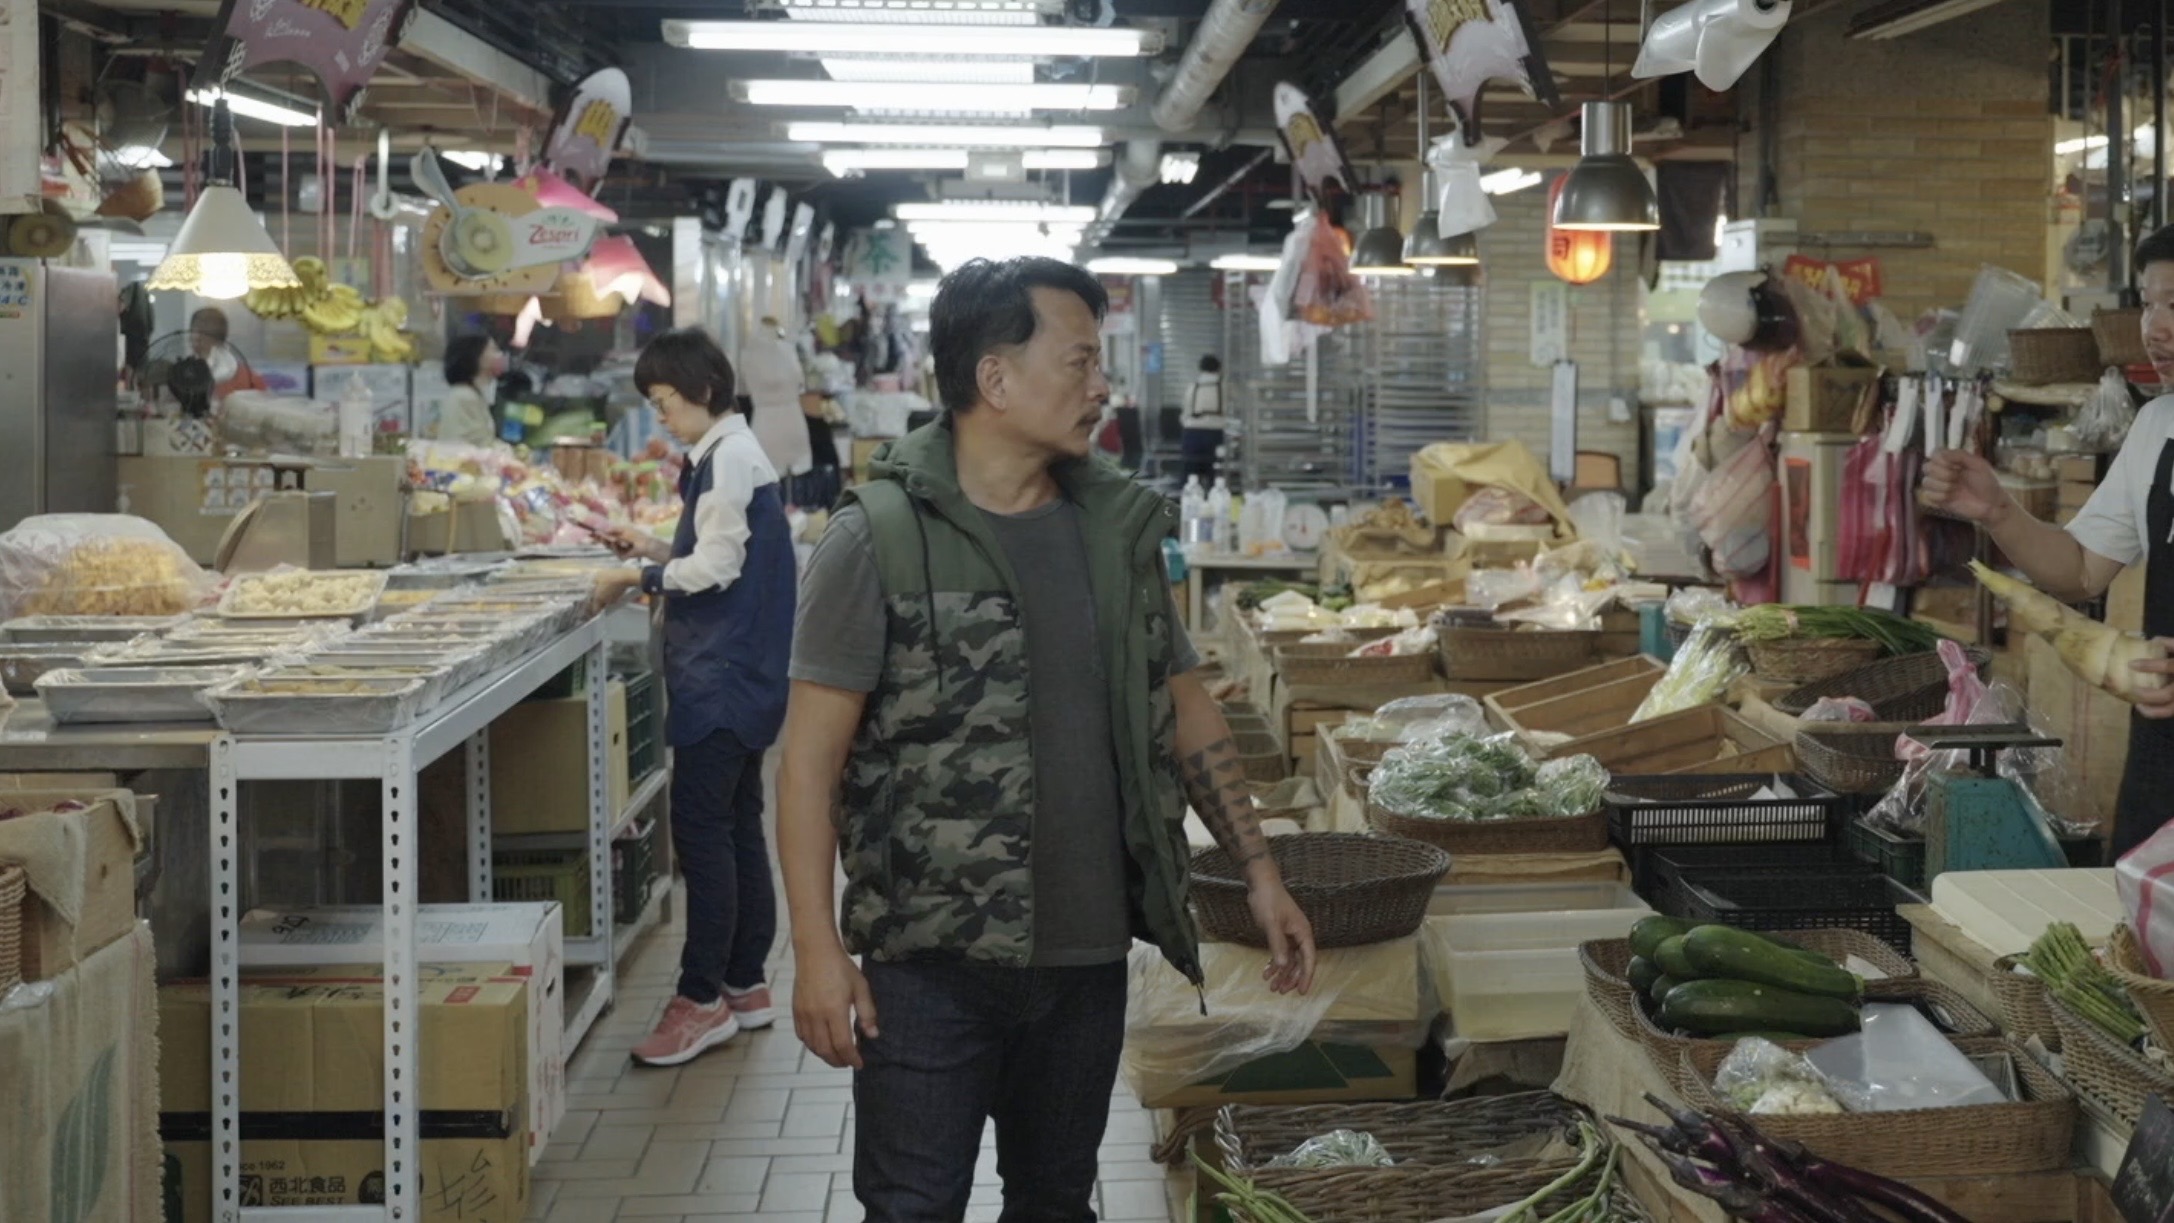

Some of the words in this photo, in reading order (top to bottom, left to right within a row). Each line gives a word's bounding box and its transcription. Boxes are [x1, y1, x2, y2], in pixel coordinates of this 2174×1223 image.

[528, 223, 580, 246] Zespri
[259, 1160, 285, 1170] 1962
[269, 1175, 346, 1194] 西北食品
